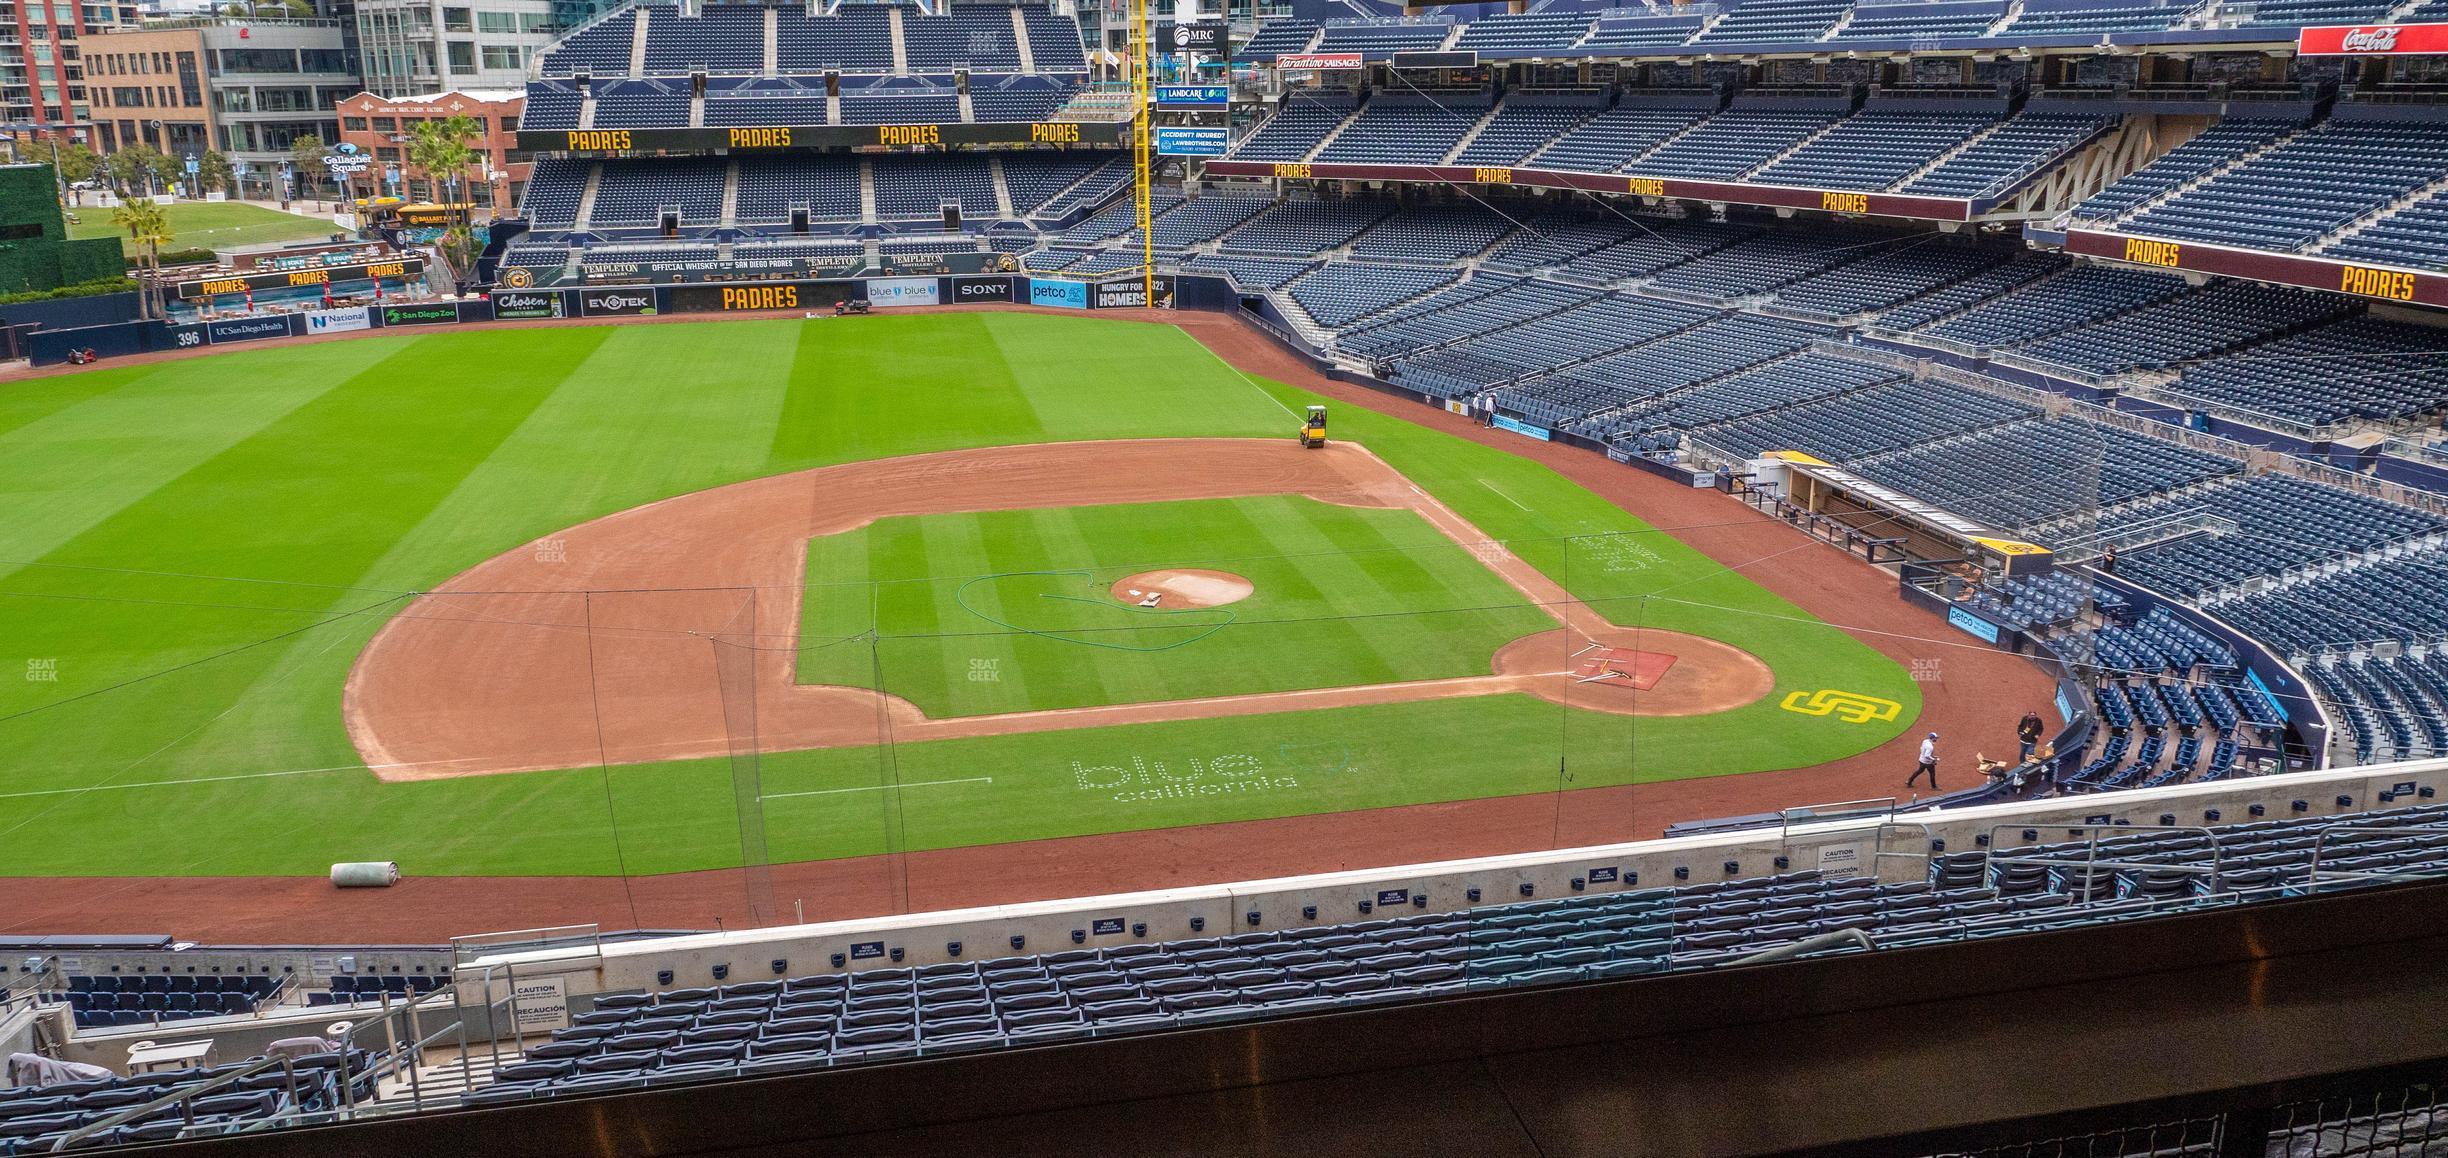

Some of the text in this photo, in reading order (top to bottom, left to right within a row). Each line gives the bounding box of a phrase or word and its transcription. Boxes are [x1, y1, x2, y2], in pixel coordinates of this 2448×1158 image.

[1190, 30, 1214, 40] MRC
[1278, 56, 1360, 68] Tarantino SAUSAGES
[1168, 89, 1227, 98] LANDCARE LOGIC
[730, 128, 791, 147] PADRES
[879, 125, 939, 145] PADRES
[1032, 123, 1079, 142] PADRES
[568, 131, 631, 150] PADRES
[323, 155, 373, 165] Gallagher
[331, 164, 368, 173] Square
[1274, 164, 1311, 178] PADRES
[1475, 167, 1511, 184] PADRES
[1629, 178, 1664, 196] PADRES
[1822, 193, 1868, 213] PADRES
[891, 254, 944, 264] TEMPLETON
[2125, 238, 2180, 267] PADRES
[651, 263, 685, 272] OFFICIAL
[686, 262, 718, 271] WHISKEY
[735, 260, 748, 269] SAN
[749, 260, 768, 268] DIEGO
[768, 259, 793, 268] PADRES
[804, 256, 859, 267] TEMPLETON
[367, 263, 404, 277] PADRES
[583, 264, 639, 274] TEMPLETON
[288, 270, 329, 286] PADRES
[2340, 265, 2415, 301] PADRES
[202, 279, 247, 295] PADRES
[870, 287, 892, 296] blue
[904, 285, 926, 295] blue
[961, 284, 1007, 295] SONY
[1033, 285, 1066, 299] petco
[1101, 282, 1143, 292] HUNGRY FOR
[1151, 280, 1164, 291] 322
[499, 294, 547, 308] Chosen
[589, 295, 648, 310] EVOTEK
[723, 286, 797, 310] PADRES
[1099, 292, 1147, 307] HOMERS
[328, 312, 365, 322] National
[402, 309, 456, 319] San Diego Zoo
[216, 322, 283, 336] UC San Diego Health
[178, 331, 200, 346] 396
[1950, 610, 1973, 627] petco
[1072, 753, 1263, 790] blue
[1113, 775, 1298, 802] california
[1825, 848, 1854, 857] CAUTION
[1824, 866, 1858, 876] RECAUCIÓN
[517, 985, 555, 994] CAUTION
[517, 1005, 566, 1015] RECAUCIÓN
